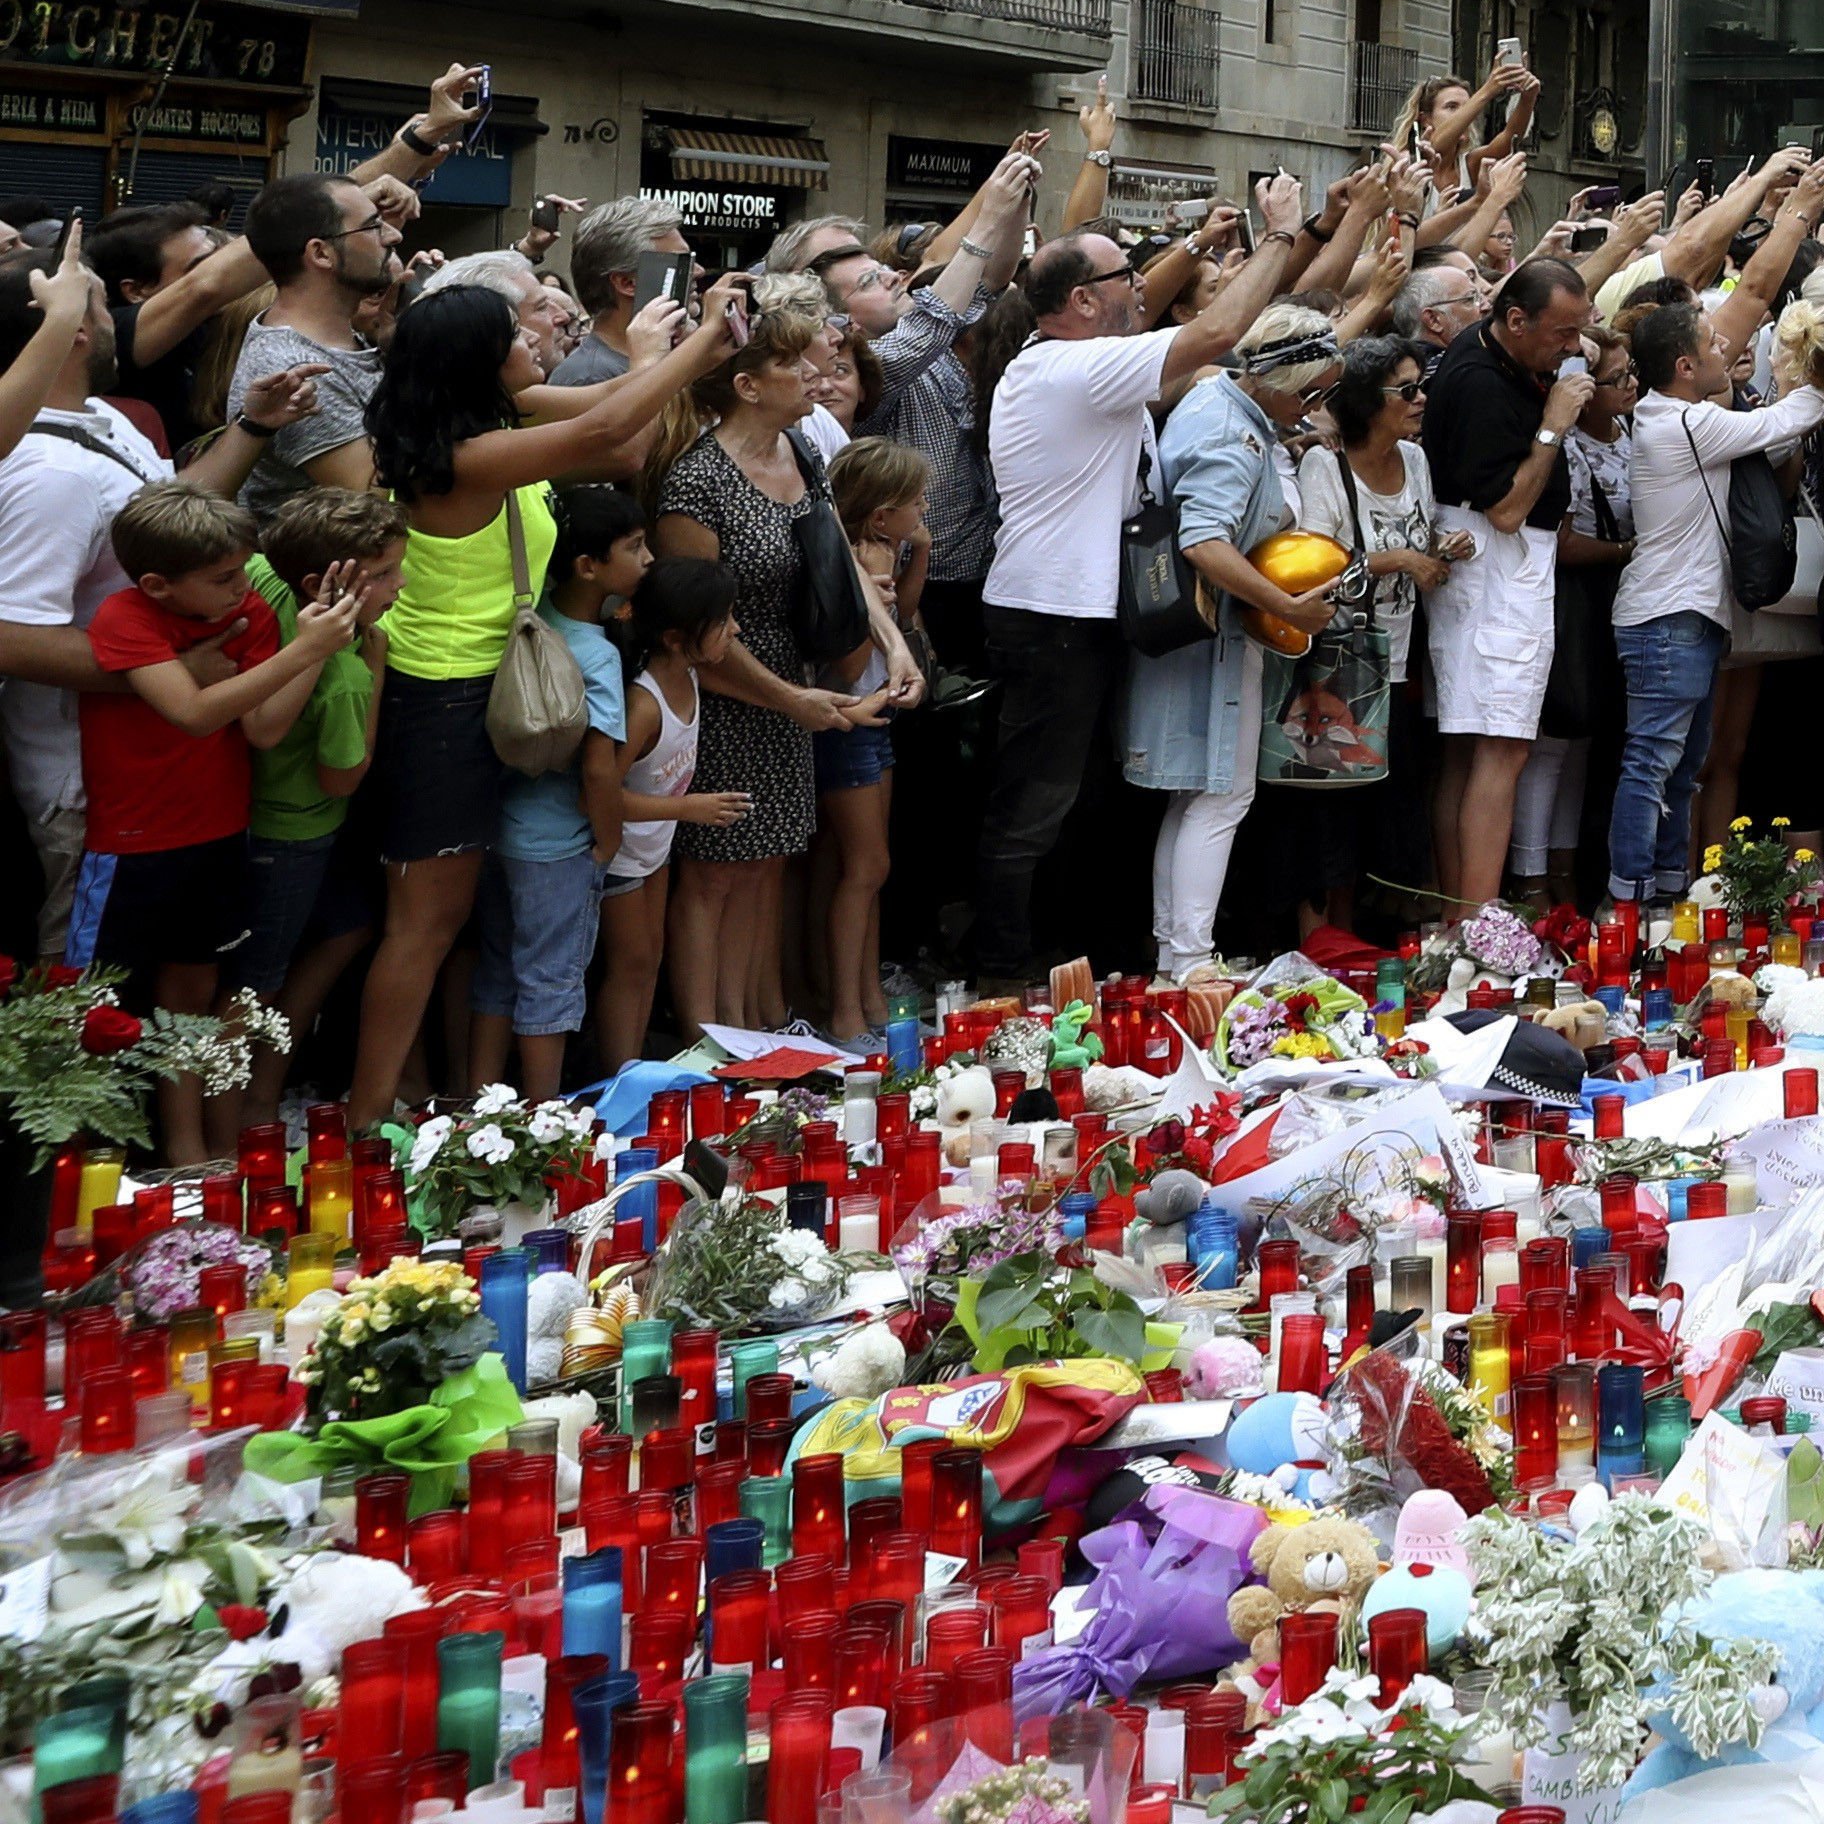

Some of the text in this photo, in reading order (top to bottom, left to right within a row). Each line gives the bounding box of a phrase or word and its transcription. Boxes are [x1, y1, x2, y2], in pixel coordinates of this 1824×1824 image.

[239, 39, 276, 76] 78
[43, 97, 54, 123] A
[61, 99, 96, 125] MIDA
[317, 116, 504, 160] NTERNNAL
[907, 153, 971, 174] MAXIMUM
[722, 194, 776, 217] STORE
[704, 215, 761, 229] PRODUCTS
[1768, 1377, 1794, 1397] Me
